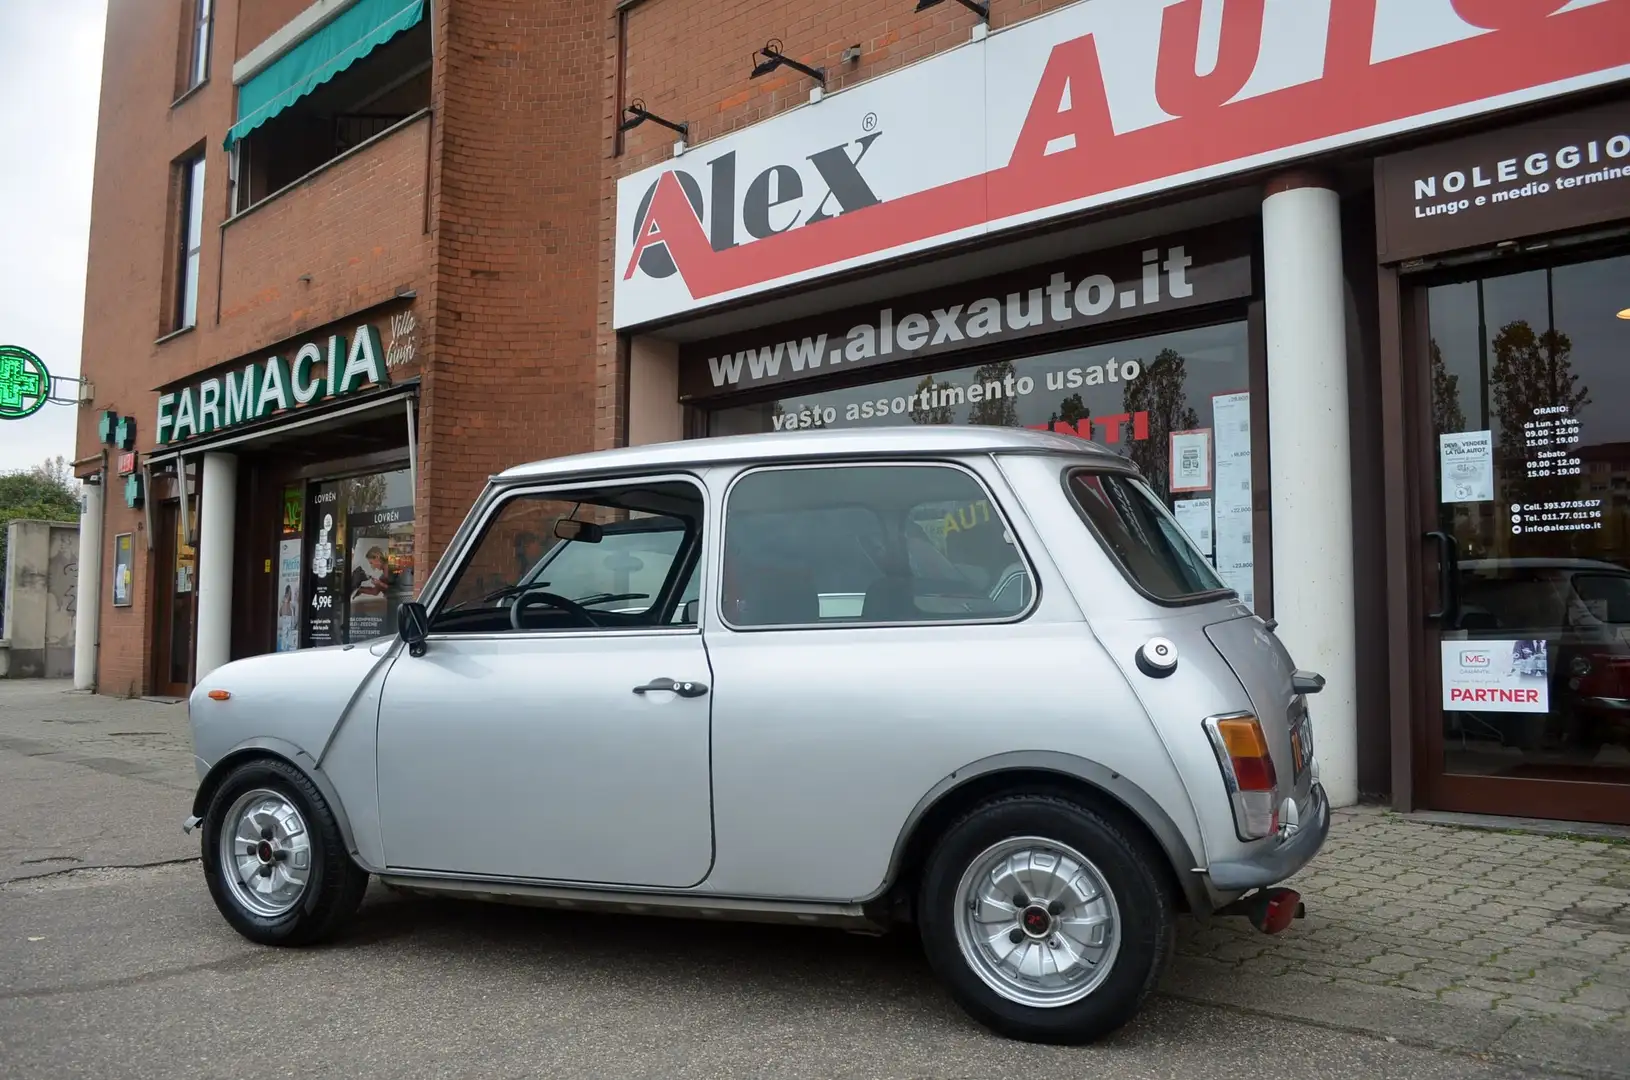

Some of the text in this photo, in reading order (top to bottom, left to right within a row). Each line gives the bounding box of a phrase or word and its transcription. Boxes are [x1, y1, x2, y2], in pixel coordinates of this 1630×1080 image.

[623, 131, 882, 300] Alex
[1006, 0, 1595, 168] AUT
[1414, 134, 1630, 200] NOLEGGIO
[1414, 166, 1630, 219] Lungo e medio termine
[708, 246, 1193, 387] www.alexauto.it
[391, 310, 415, 339] Villa
[156, 324, 383, 445] FARMACIA
[772, 357, 1140, 431] vasto assortimento usato
[1533, 405, 1569, 415] ORARIO:
[1524, 421, 1534, 429] da
[1536, 420, 1553, 428] Lun.
[1525, 429, 1548, 438] 09.00
[1556, 426, 1579, 435] 12.00
[1461, 439, 1488, 447] VENDERE
[1526, 438, 1548, 447] 15.00
[1556, 436, 1579, 444] 19.00
[1537, 450, 1566, 459] Sabato
[1526, 460, 1550, 468] 09.00
[1557, 458, 1580, 466] 12.00
[1527, 469, 1550, 478] 15.00
[1557, 467, 1580, 476] 19.00
[1523, 503, 1542, 511] Cell.
[374, 510, 399, 523] LOVRÉN
[1524, 514, 1540, 522] Tel.
[1524, 521, 1601, 533] info@alexauto.it
[312, 594, 332, 611] 4,99€
[1450, 688, 1539, 703] PARTNER
